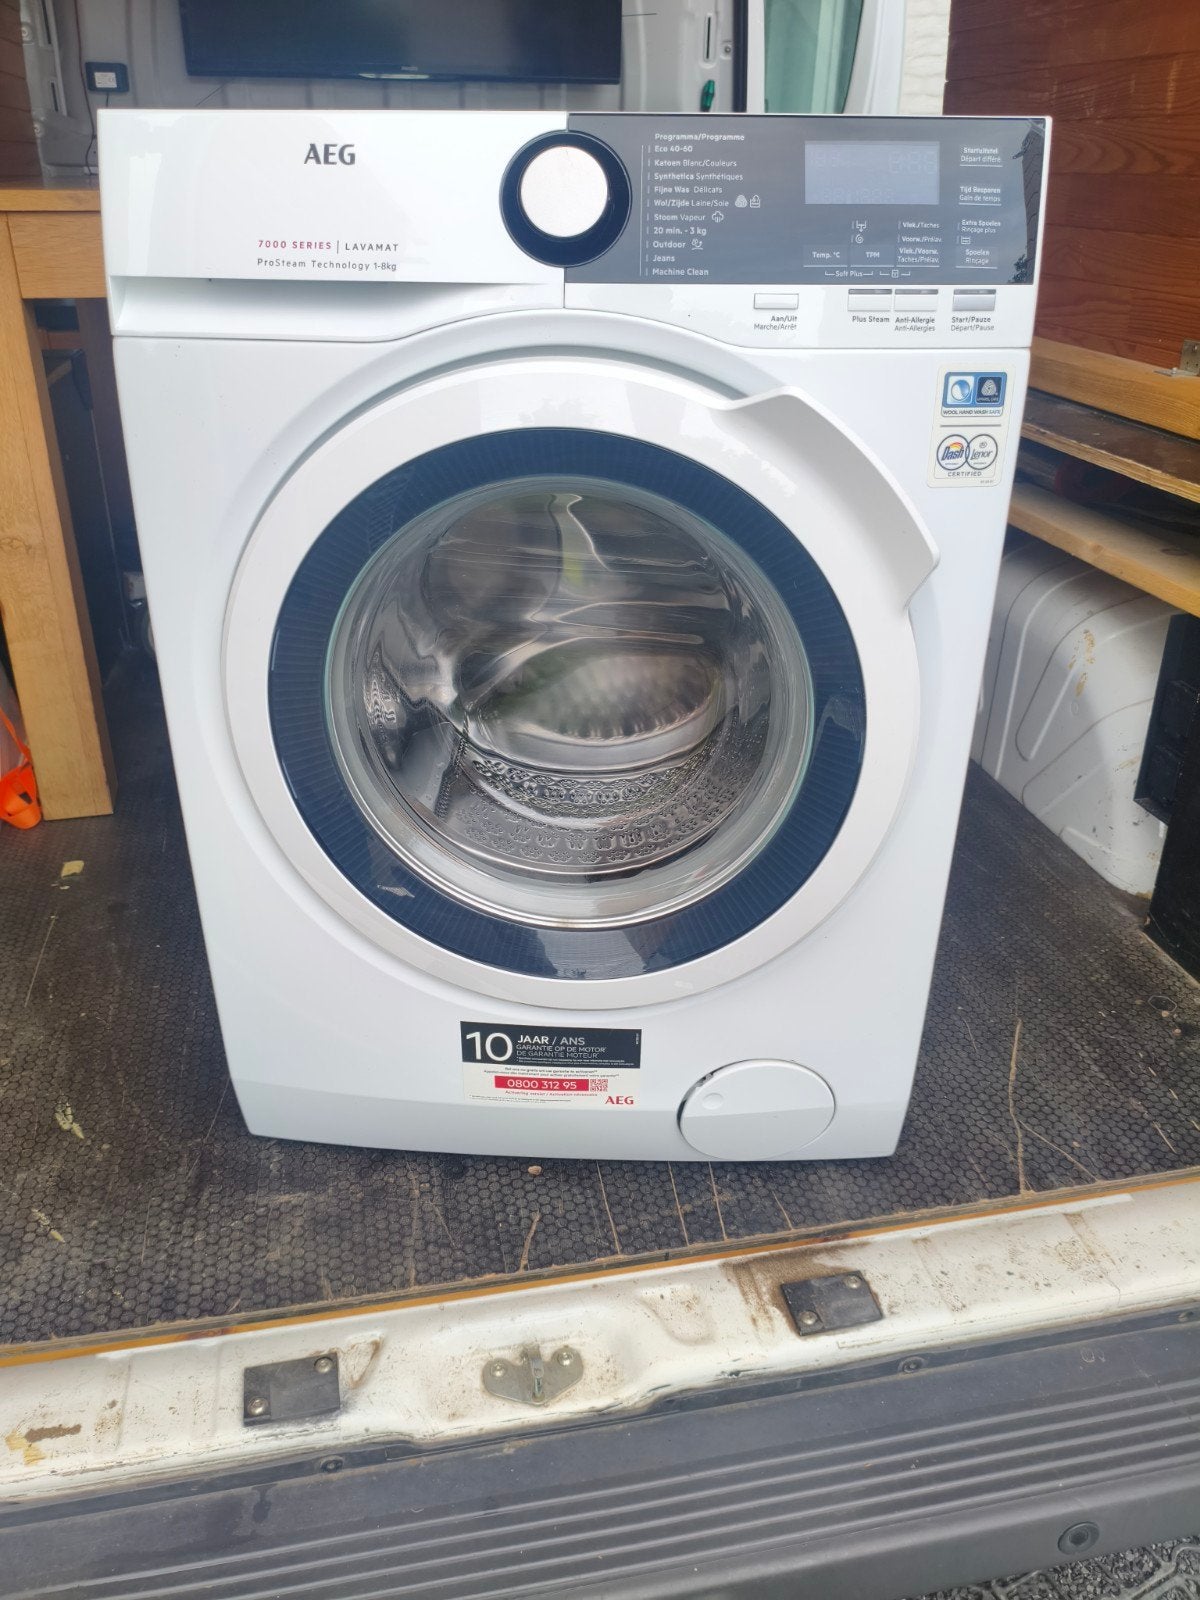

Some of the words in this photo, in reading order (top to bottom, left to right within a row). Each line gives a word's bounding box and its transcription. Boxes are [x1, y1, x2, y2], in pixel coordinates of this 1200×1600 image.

[654, 133, 745, 142] Programma/Programme
[304, 143, 356, 166] AEG
[654, 186, 673, 194] Fijne
[654, 200, 690, 208] Wol/Zijde
[680, 214, 706, 222] Vapeur
[696, 227, 707, 236] kg
[258, 240, 287, 248] 7000
[292, 241, 332, 250] SERIES
[345, 243, 399, 251] LAVAMAT
[812, 251, 831, 260] Temp.
[257, 259, 306, 268] ProSteam
[312, 260, 370, 271] Technology
[374, 262, 397, 271] 1-8kg
[652, 268, 685, 276] Machine
[687, 268, 709, 276] Clean
[771, 315, 798, 323] Aan/Uit
[852, 315, 867, 323] Plus
[868, 315, 890, 323] Steam
[895, 316, 935, 325] Anti-Allergie
[952, 316, 991, 324] Start/Pauze
[753, 323, 797, 331] Marche/Arrêt
[894, 324, 935, 333] Anti-Allergies
[950, 323, 995, 332] Départ/Pause
[941, 446, 965, 461] Dash
[970, 449, 993, 460] Lenor
[517, 1035, 549, 1045] JAAR
[552, 1036, 557, 1045] /
[560, 1037, 585, 1045] ANS
[465, 1031, 513, 1062] 10
[516, 1044, 553, 1052] GARANTIE
[507, 1079, 539, 1089] 0800
[541, 1080, 560, 1090] 312
[563, 1081, 577, 1090] 95
[605, 1096, 634, 1105] AEG
